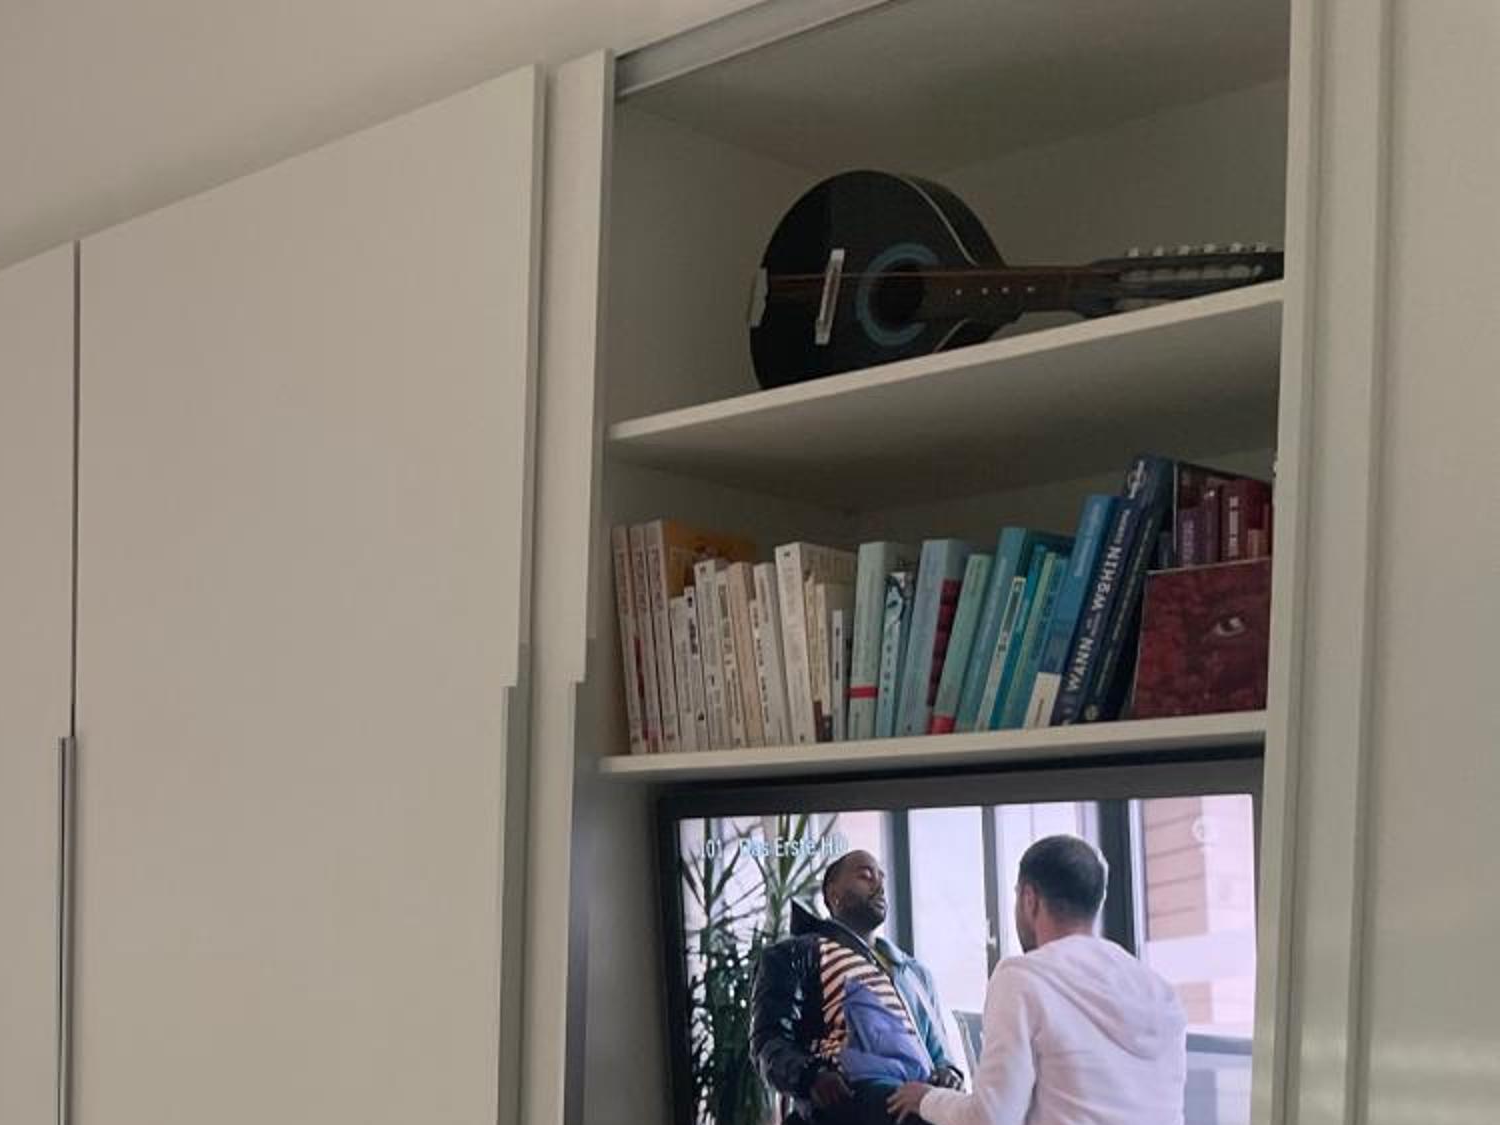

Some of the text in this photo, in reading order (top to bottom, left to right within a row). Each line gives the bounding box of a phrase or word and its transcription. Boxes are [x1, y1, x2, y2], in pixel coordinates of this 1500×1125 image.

[1065, 637, 1096, 692] WANN
[1090, 545, 1124, 611] WOHIN
[739, 837, 769, 857] Das
[775, 835, 816, 857] Erste
